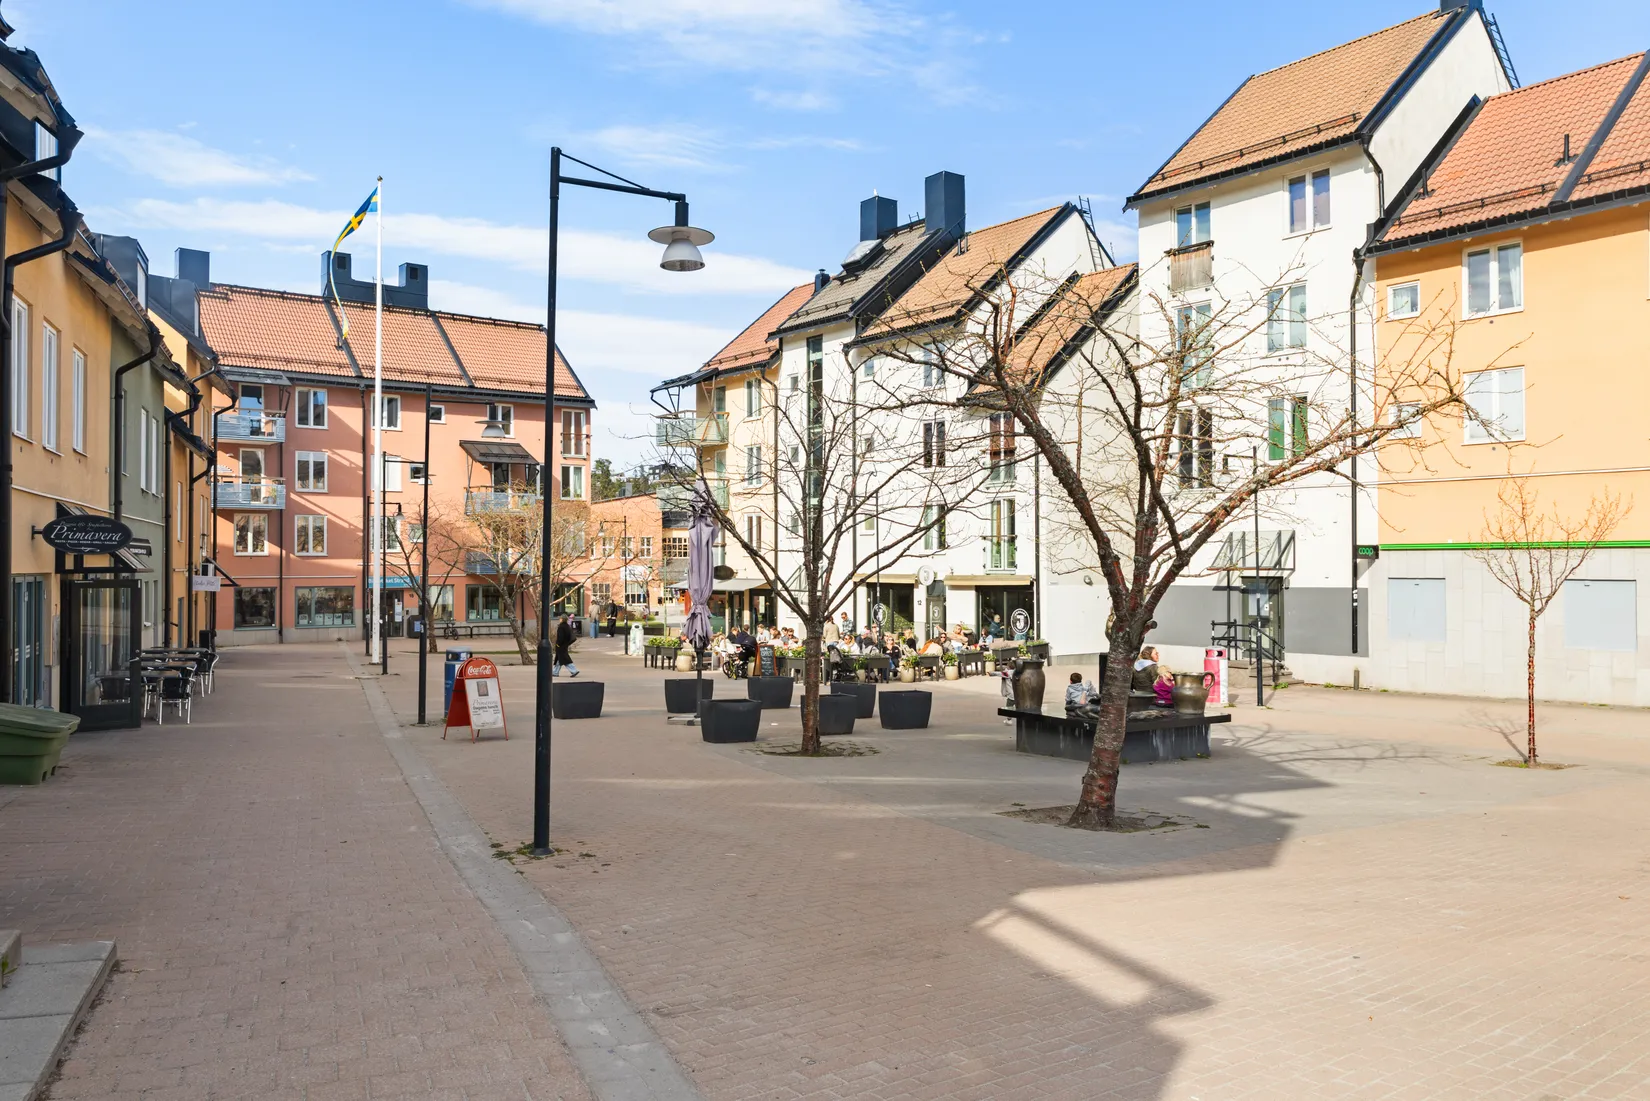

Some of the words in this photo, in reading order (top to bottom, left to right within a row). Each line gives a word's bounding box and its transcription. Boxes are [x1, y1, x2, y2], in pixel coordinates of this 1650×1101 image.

[50, 525, 124, 541] Primavera
[1358, 547, 1373, 556] coop
[1016, 615, 1025, 630] J
